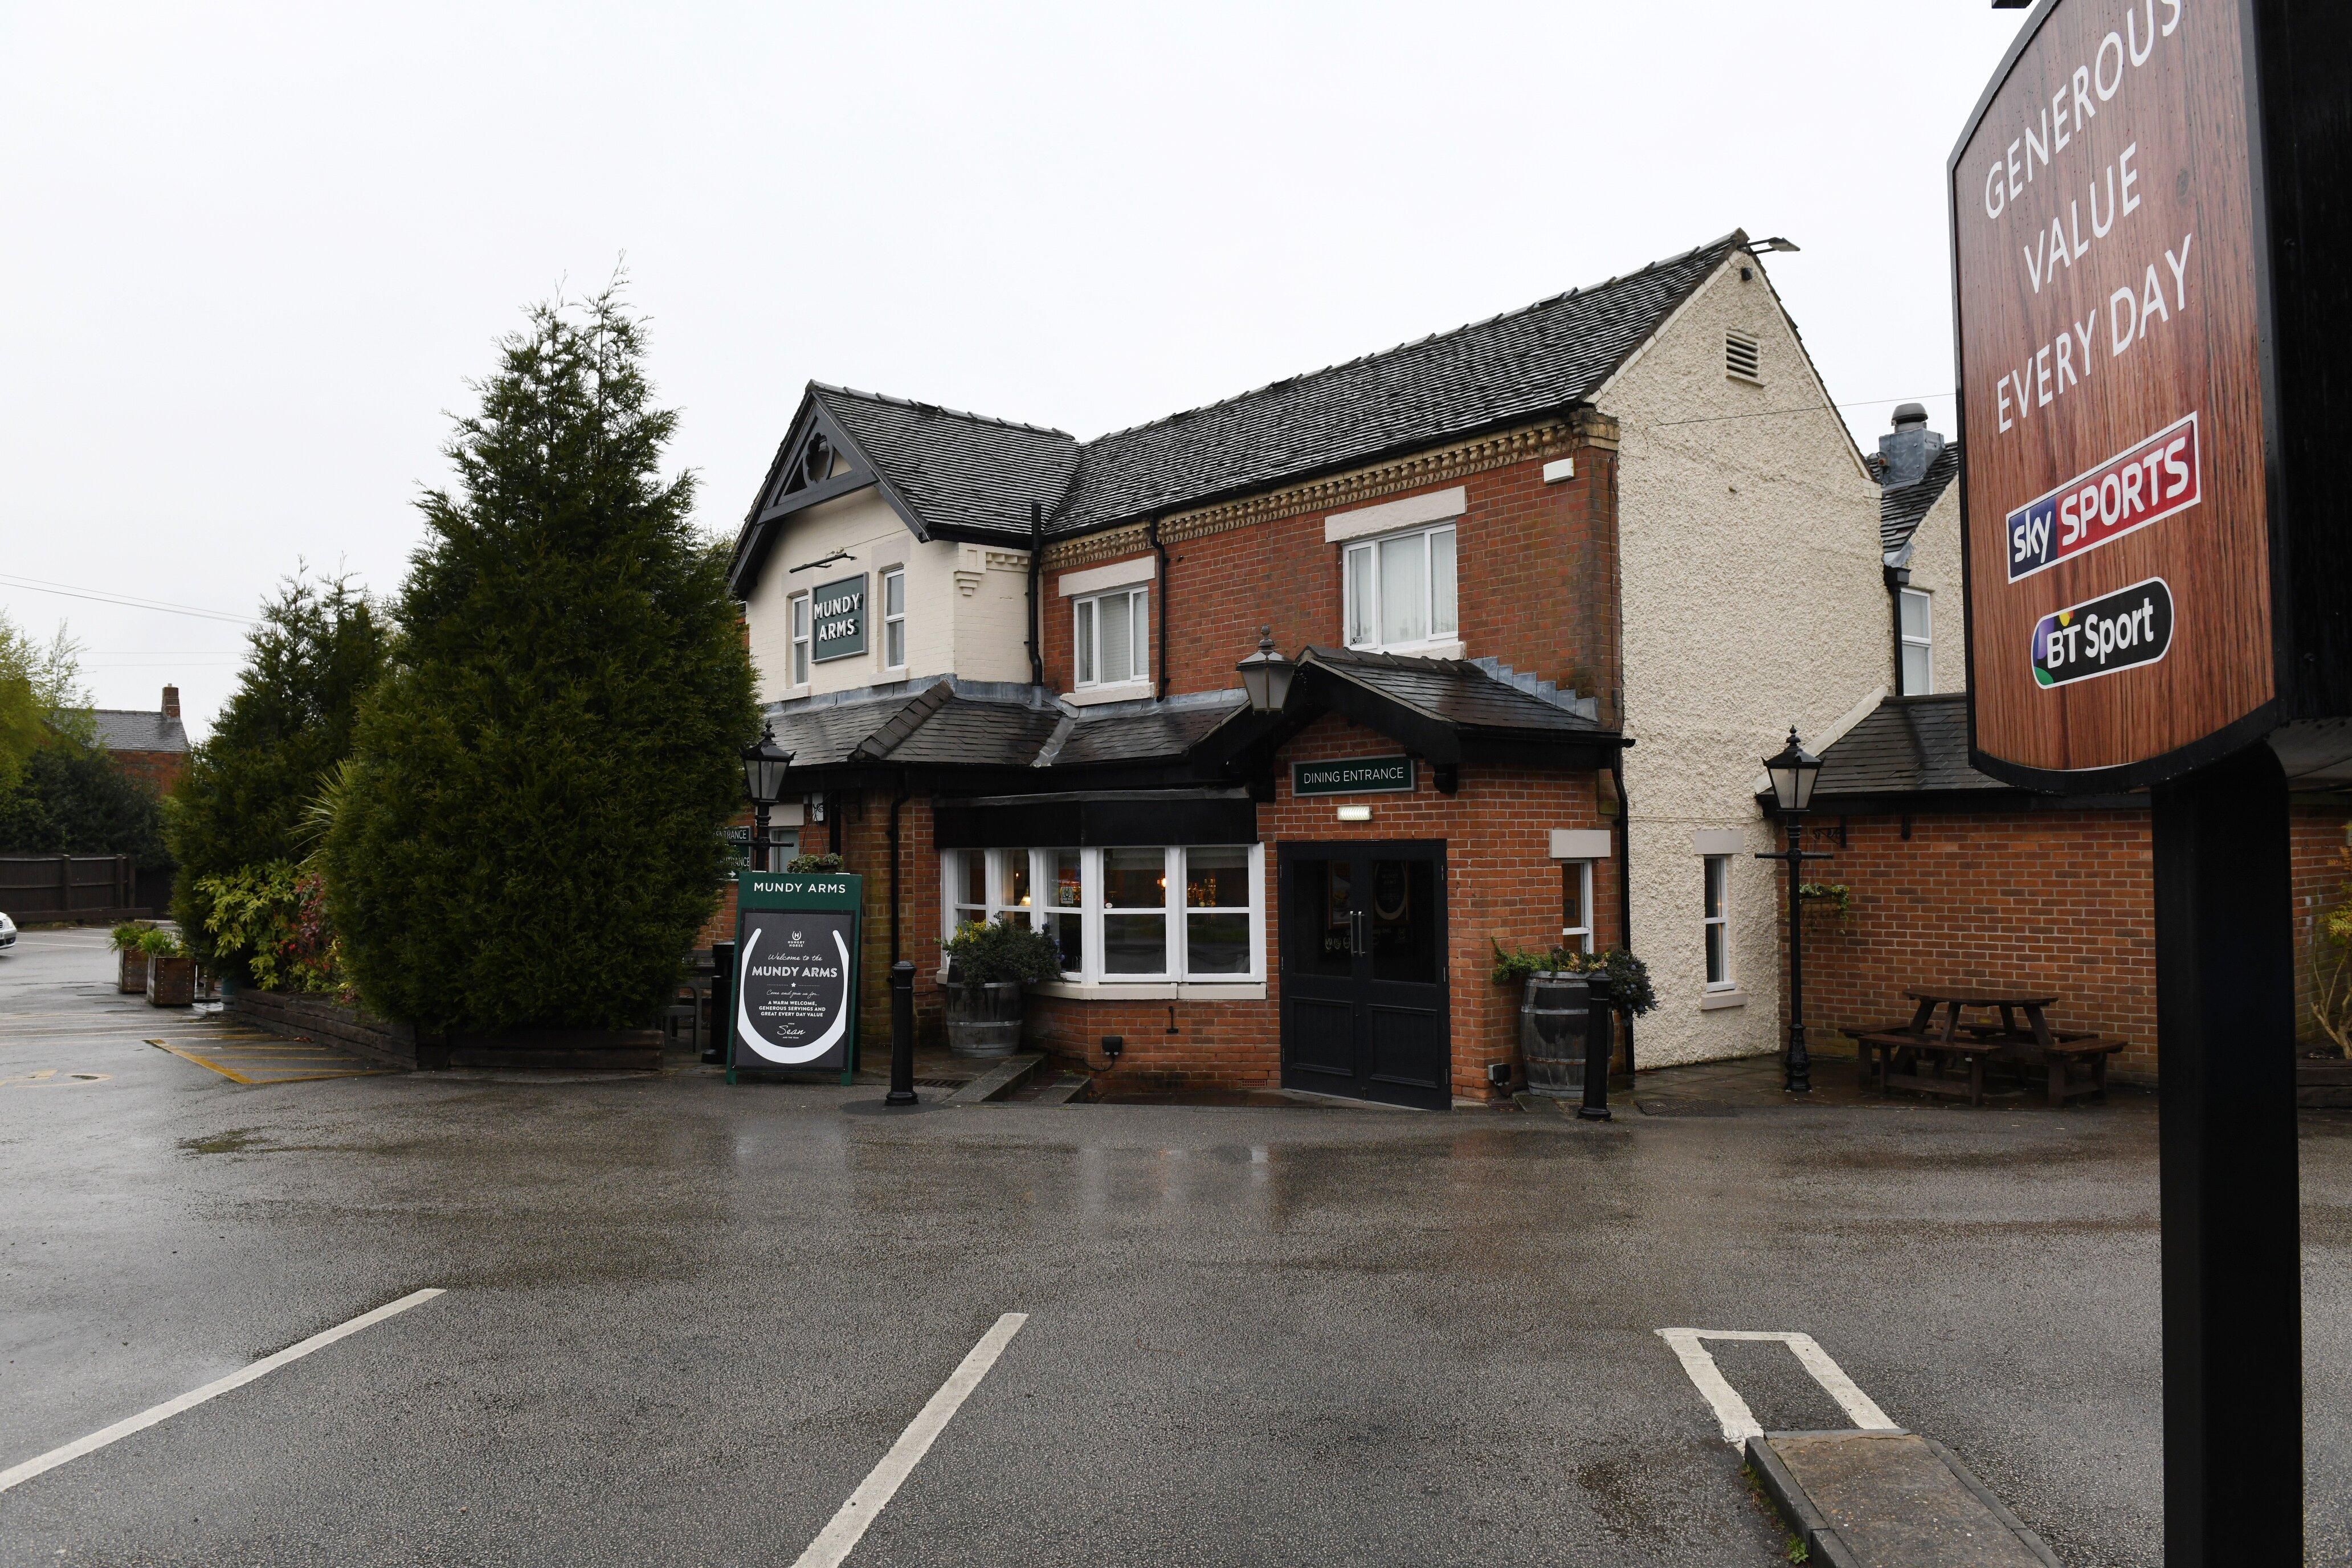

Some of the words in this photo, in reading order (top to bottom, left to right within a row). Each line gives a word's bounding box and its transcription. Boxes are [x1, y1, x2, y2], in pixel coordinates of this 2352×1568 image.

[2024, 141, 2141, 294] VALUE
[1997, 308, 2096, 434] EVERY
[2110, 233, 2191, 357] DAY
[2014, 510, 2052, 564] sky
[2060, 436, 2188, 546] SPORTS
[814, 593, 860, 620] MUNDY
[818, 618, 855, 642] ARMS
[2047, 624, 2081, 669] BT
[2085, 598, 2154, 664] Sport
[1304, 771, 1340, 784] DINING
[1344, 767, 1404, 782] ENTRANCE
[754, 883, 803, 892] MUNDY
[808, 884, 846, 893] ARMS
[768, 952, 801, 961] Welcome
[752, 966, 799, 977] MUNDY
[802, 967, 838, 978] ARMS
[777, 1025, 806, 1035] Sean
